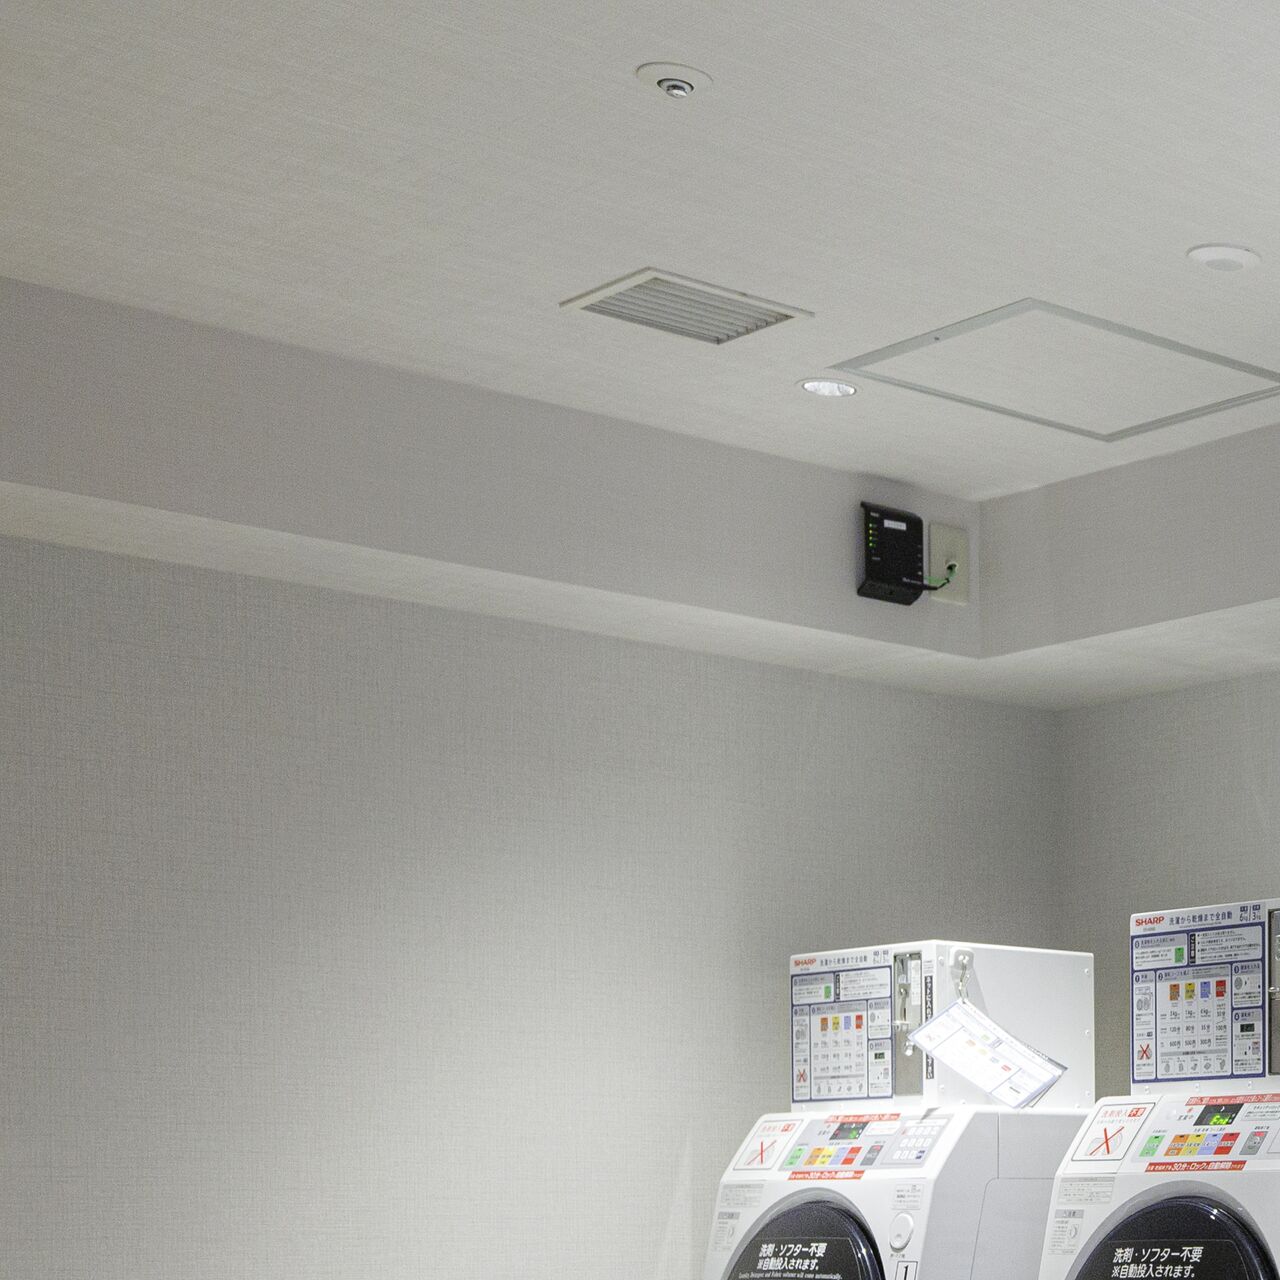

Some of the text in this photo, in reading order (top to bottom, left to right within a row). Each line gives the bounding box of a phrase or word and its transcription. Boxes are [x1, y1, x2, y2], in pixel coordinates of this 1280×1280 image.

[1135, 916, 1165, 927] SHARP
[794, 958, 817, 967] SHARP
[1112, 1246, 1204, 1263] 洗剤・ソフター不要
